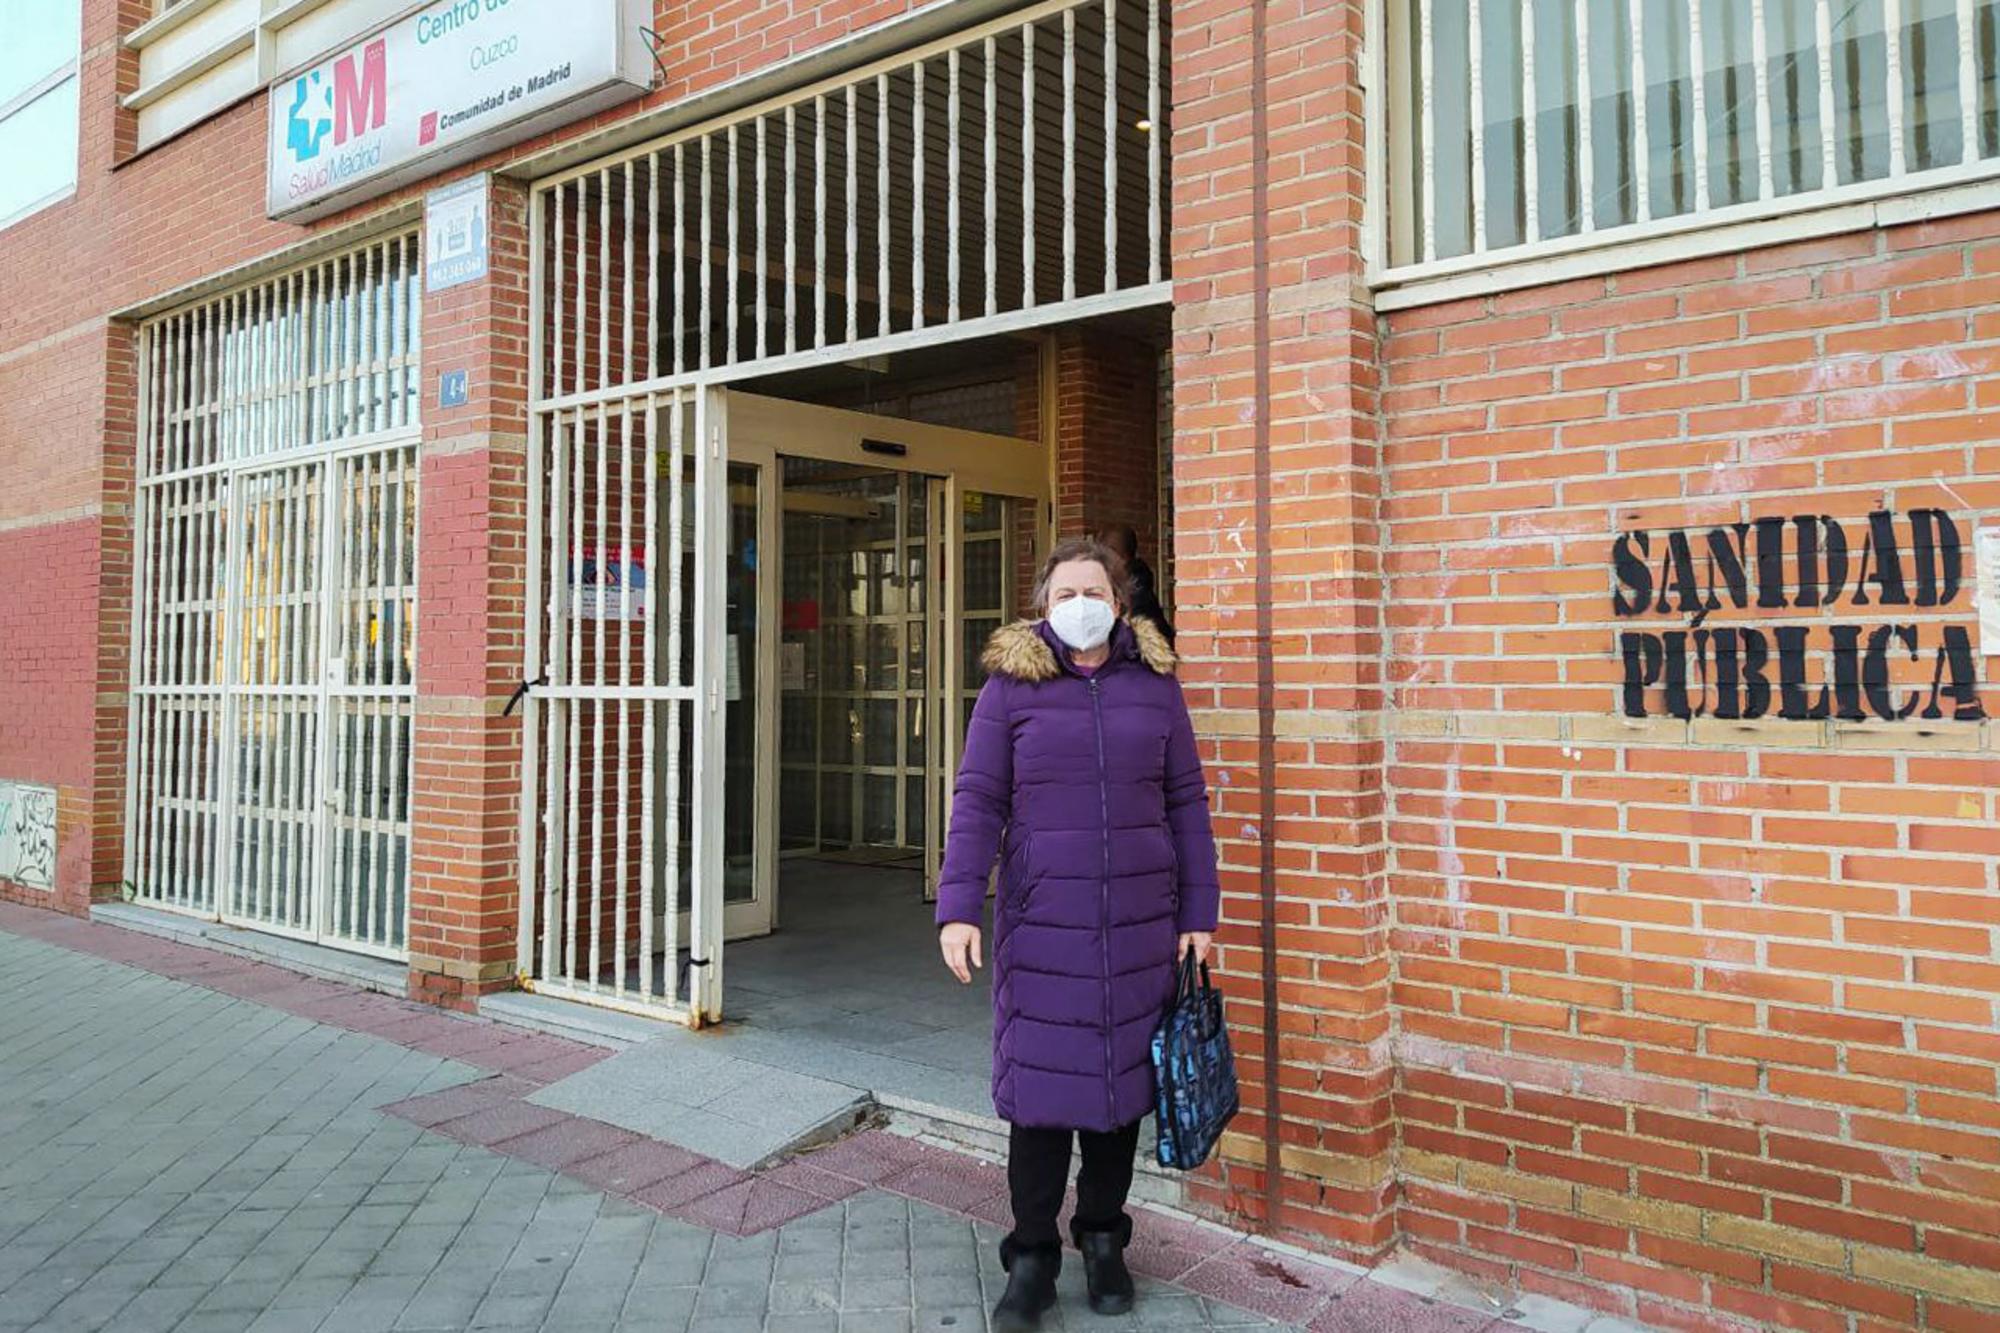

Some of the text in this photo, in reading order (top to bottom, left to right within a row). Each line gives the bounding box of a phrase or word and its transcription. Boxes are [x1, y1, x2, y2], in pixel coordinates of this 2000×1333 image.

[418, 0, 480, 44] Centro
[470, 34, 518, 70] Cuzco
[440, 62, 571, 130] Comunidad de Madrid
[1613, 508, 1962, 616] SANIDAD
[1620, 608, 1988, 723] PÚBLICA
